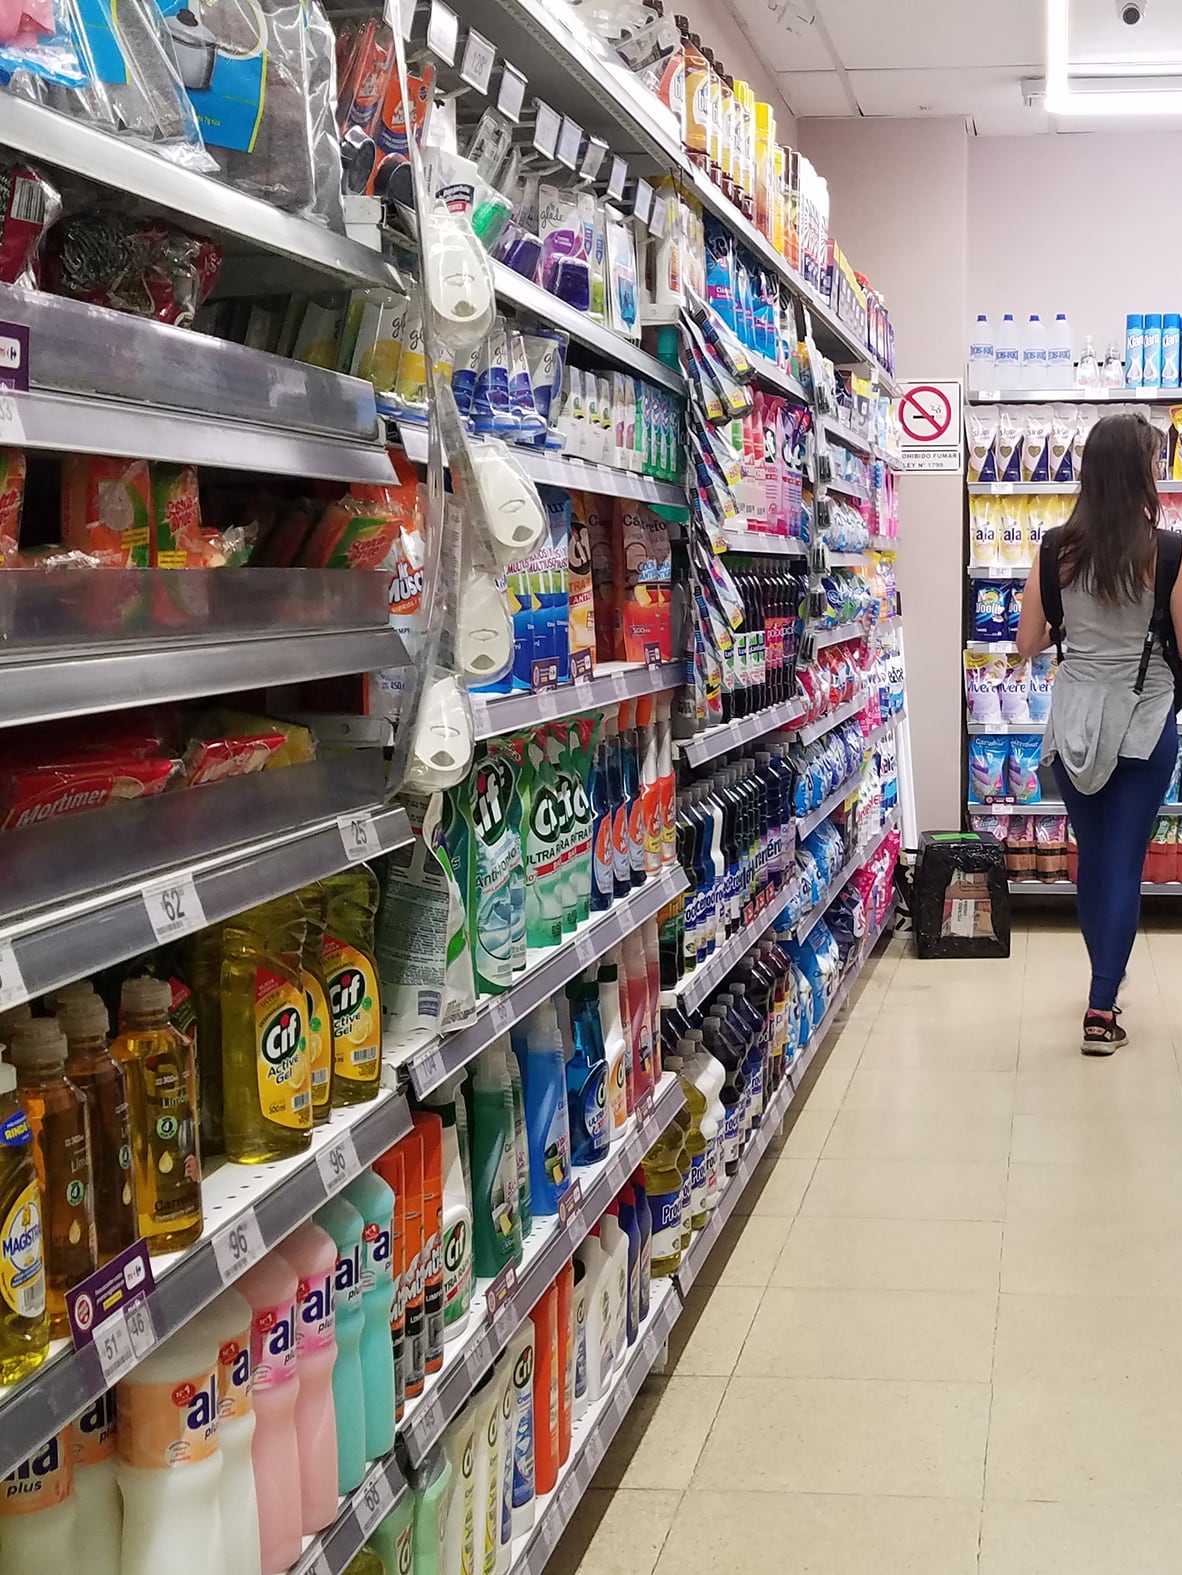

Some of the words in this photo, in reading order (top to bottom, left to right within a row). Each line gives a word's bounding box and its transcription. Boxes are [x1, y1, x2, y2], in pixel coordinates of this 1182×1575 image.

[1003, 528, 1022, 542] ala
[15, 788, 107, 828] Mortimer
[161, 889, 186, 921] 62
[330, 974, 361, 1014] Cif
[266, 1012, 298, 1060] Cif
[268, 1055, 299, 1079] Active
[275, 1070, 293, 1085] Gel
[514, 1346, 533, 1387] Cif
[7, 1480, 42, 1498] plus
